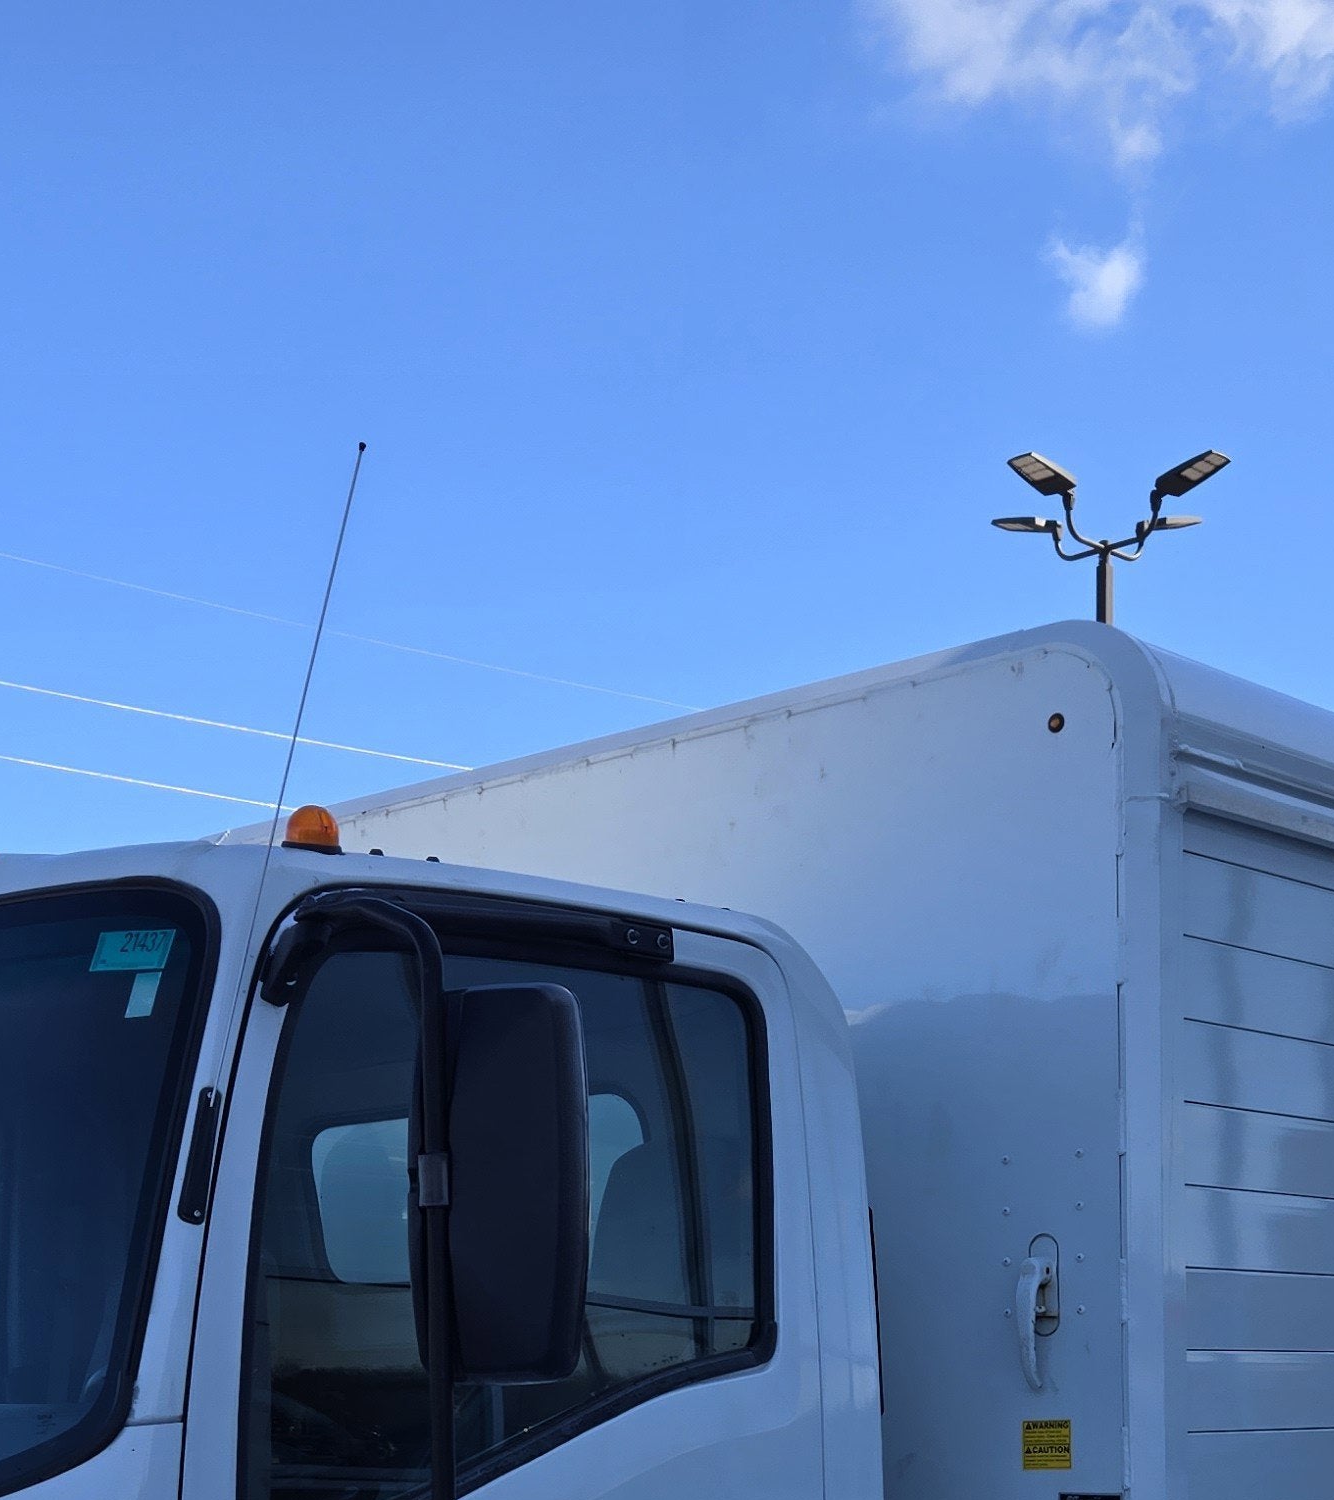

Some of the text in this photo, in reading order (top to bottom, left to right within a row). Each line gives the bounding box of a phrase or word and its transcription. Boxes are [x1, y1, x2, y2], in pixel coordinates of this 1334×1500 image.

[120, 931, 168, 952] 21437
[1033, 1421, 1069, 1429] WARNING
[1033, 1446, 1070, 1454] CAUTION
